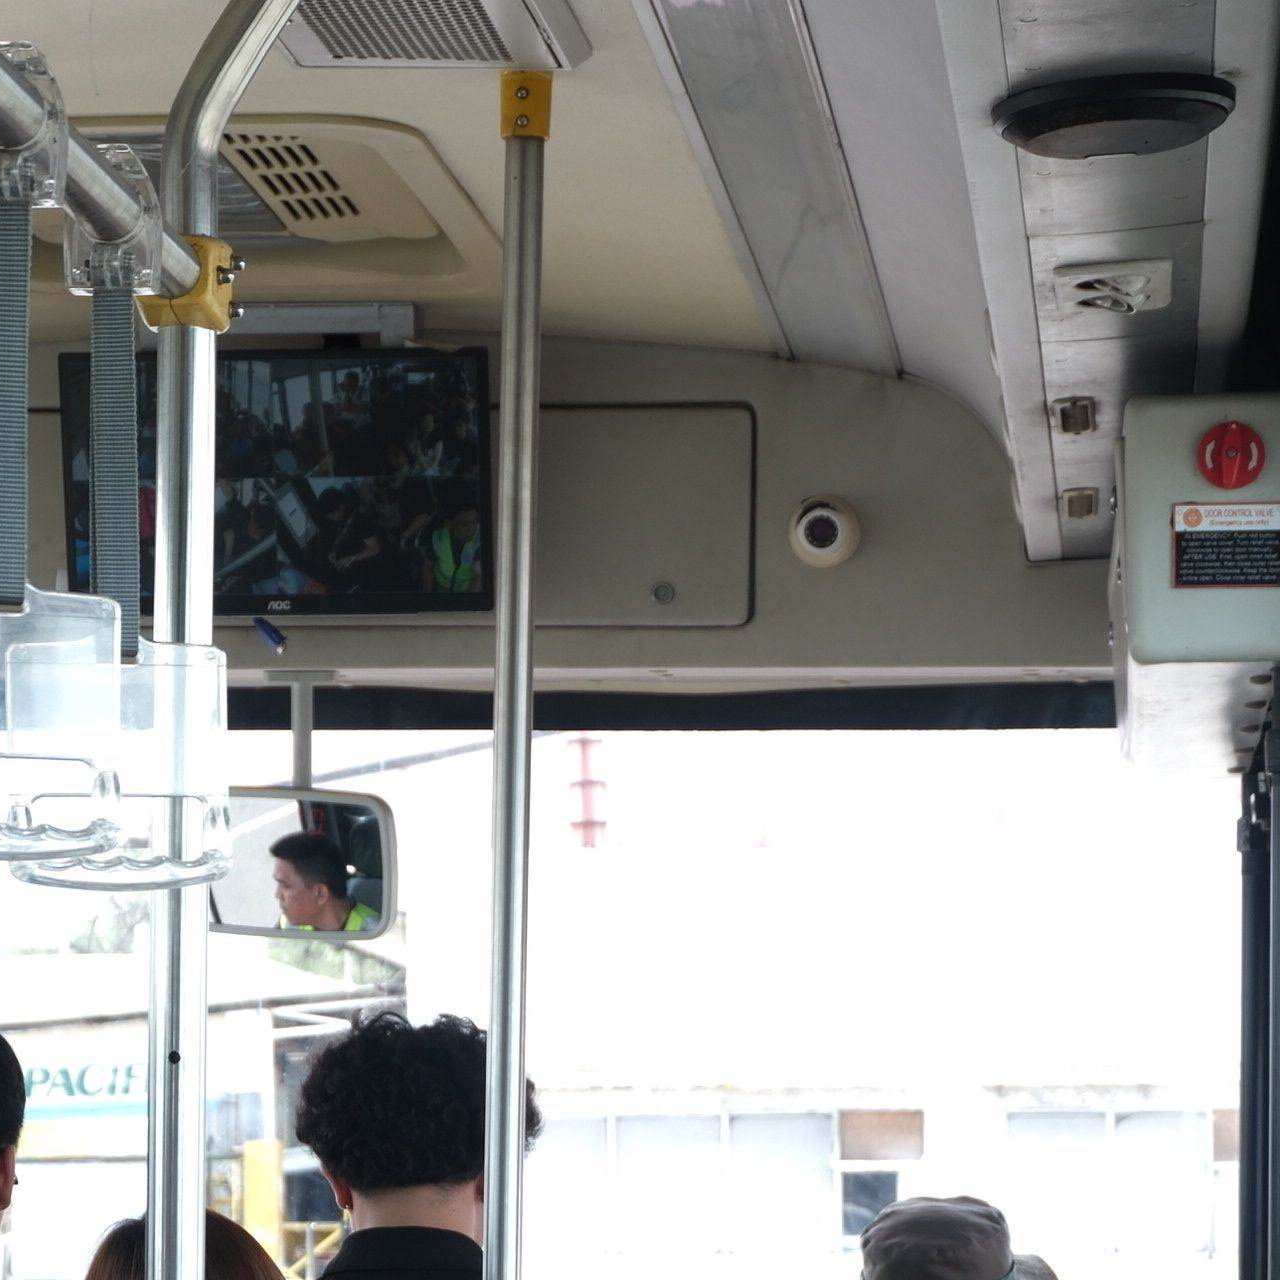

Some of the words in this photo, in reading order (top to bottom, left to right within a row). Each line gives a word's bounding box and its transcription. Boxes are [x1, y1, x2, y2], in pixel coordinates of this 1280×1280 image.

[1204, 508, 1223, 517] DOOR
[1223, 508, 1253, 517] CONTROL
[1255, 508, 1275, 517] VALVE
[267, 600, 291, 611] AOC
[24, 1063, 149, 1098] PACIF
